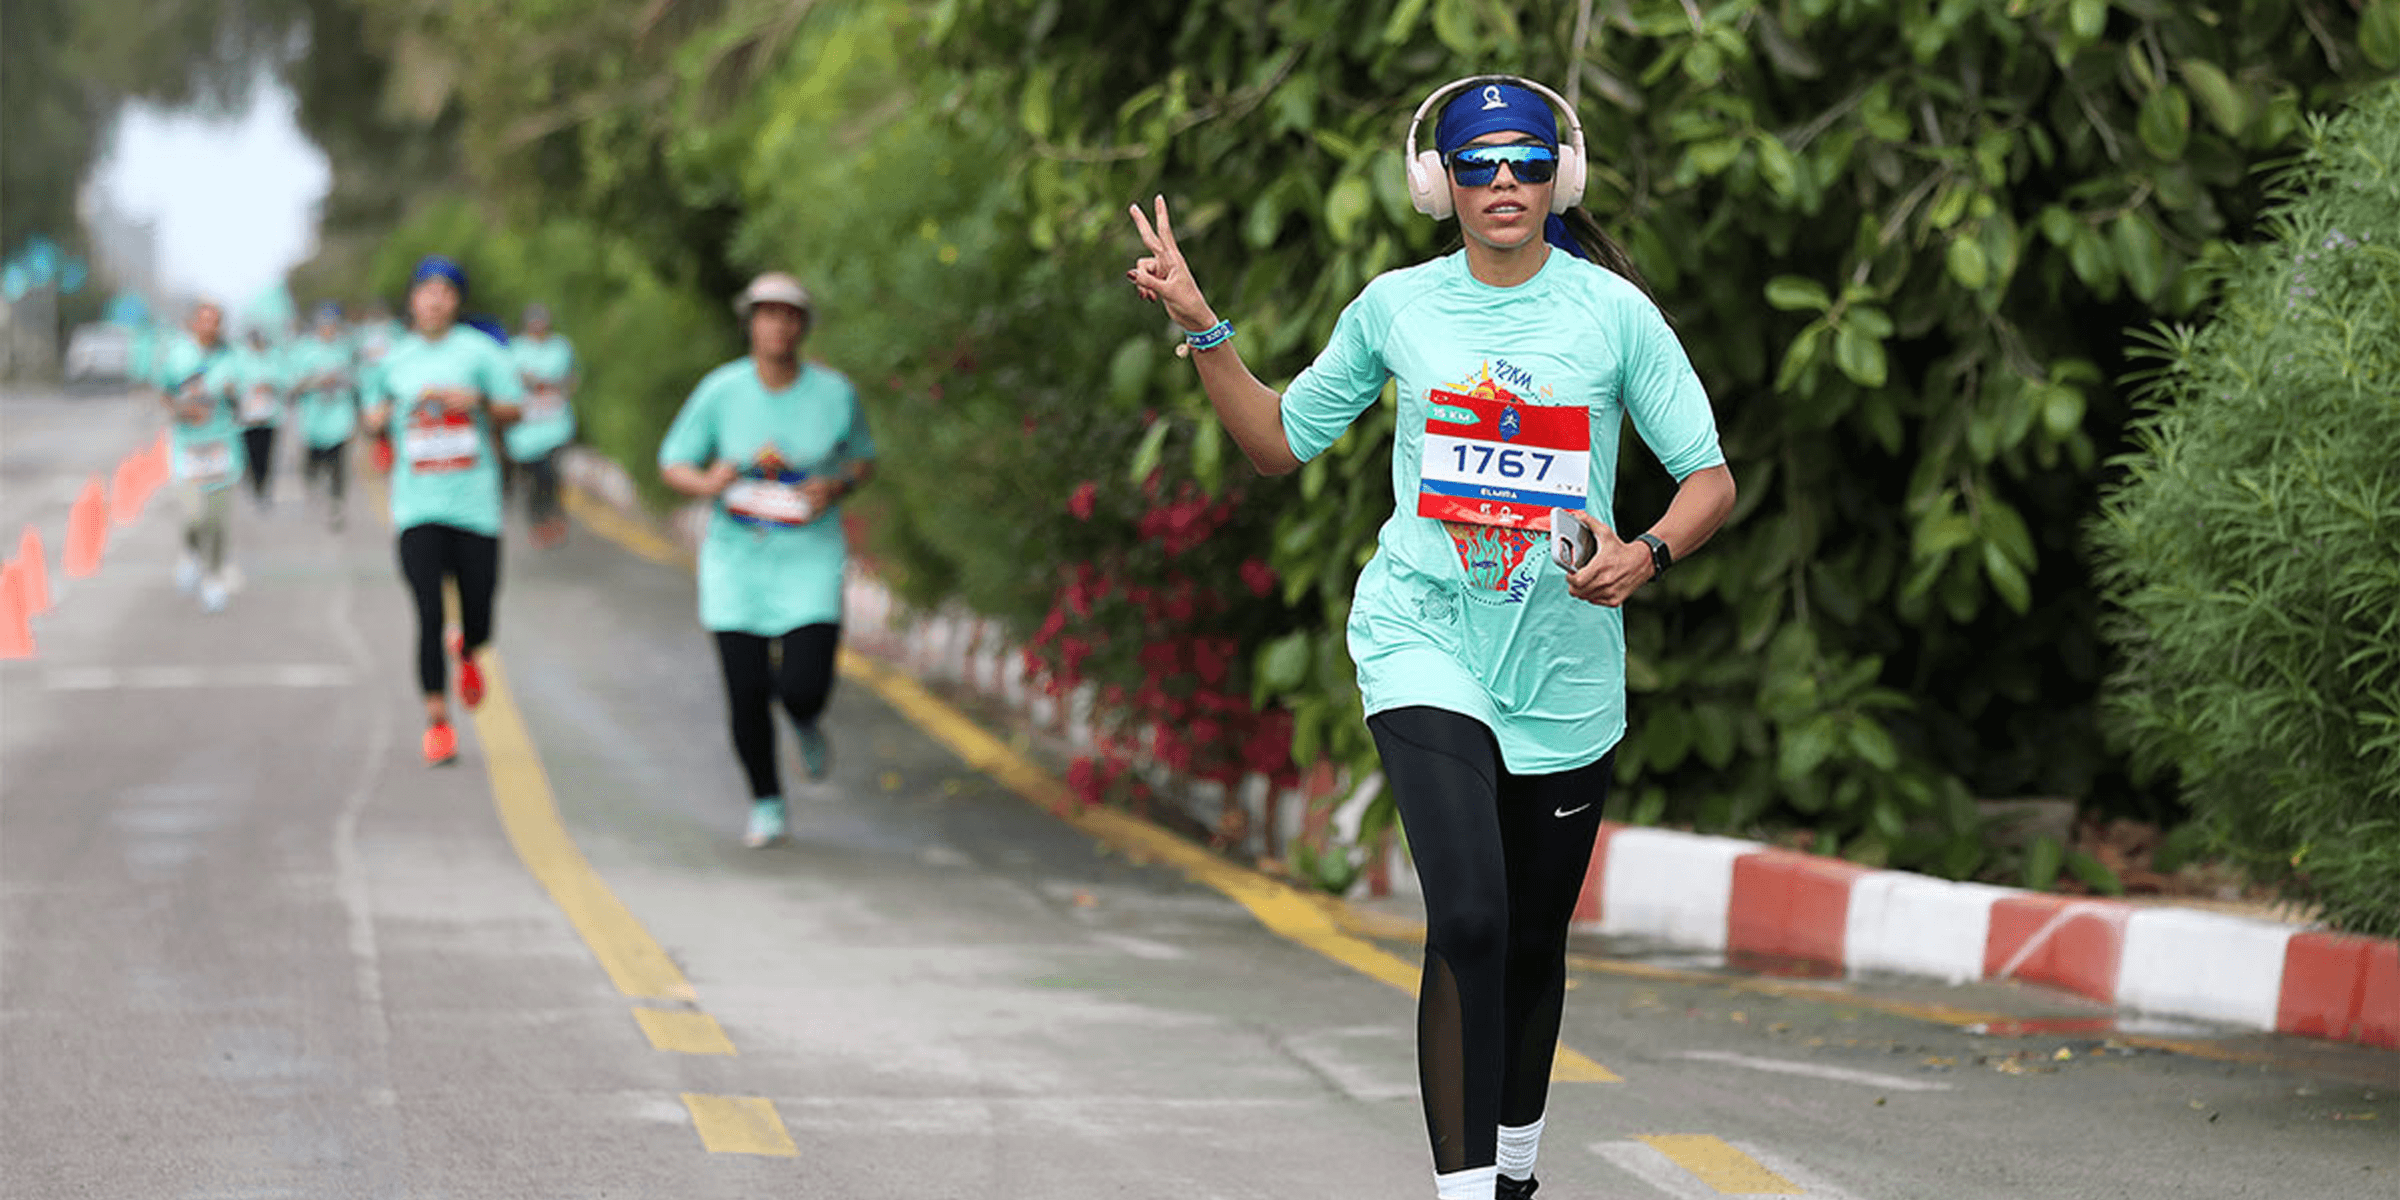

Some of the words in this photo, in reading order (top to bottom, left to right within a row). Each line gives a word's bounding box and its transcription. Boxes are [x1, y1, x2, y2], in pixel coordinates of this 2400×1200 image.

[1494, 358, 1532, 392] 42KM
[1449, 409, 1471, 421] KM
[1453, 444, 1555, 482] 1767
[1505, 570, 1535, 604] 5KM
